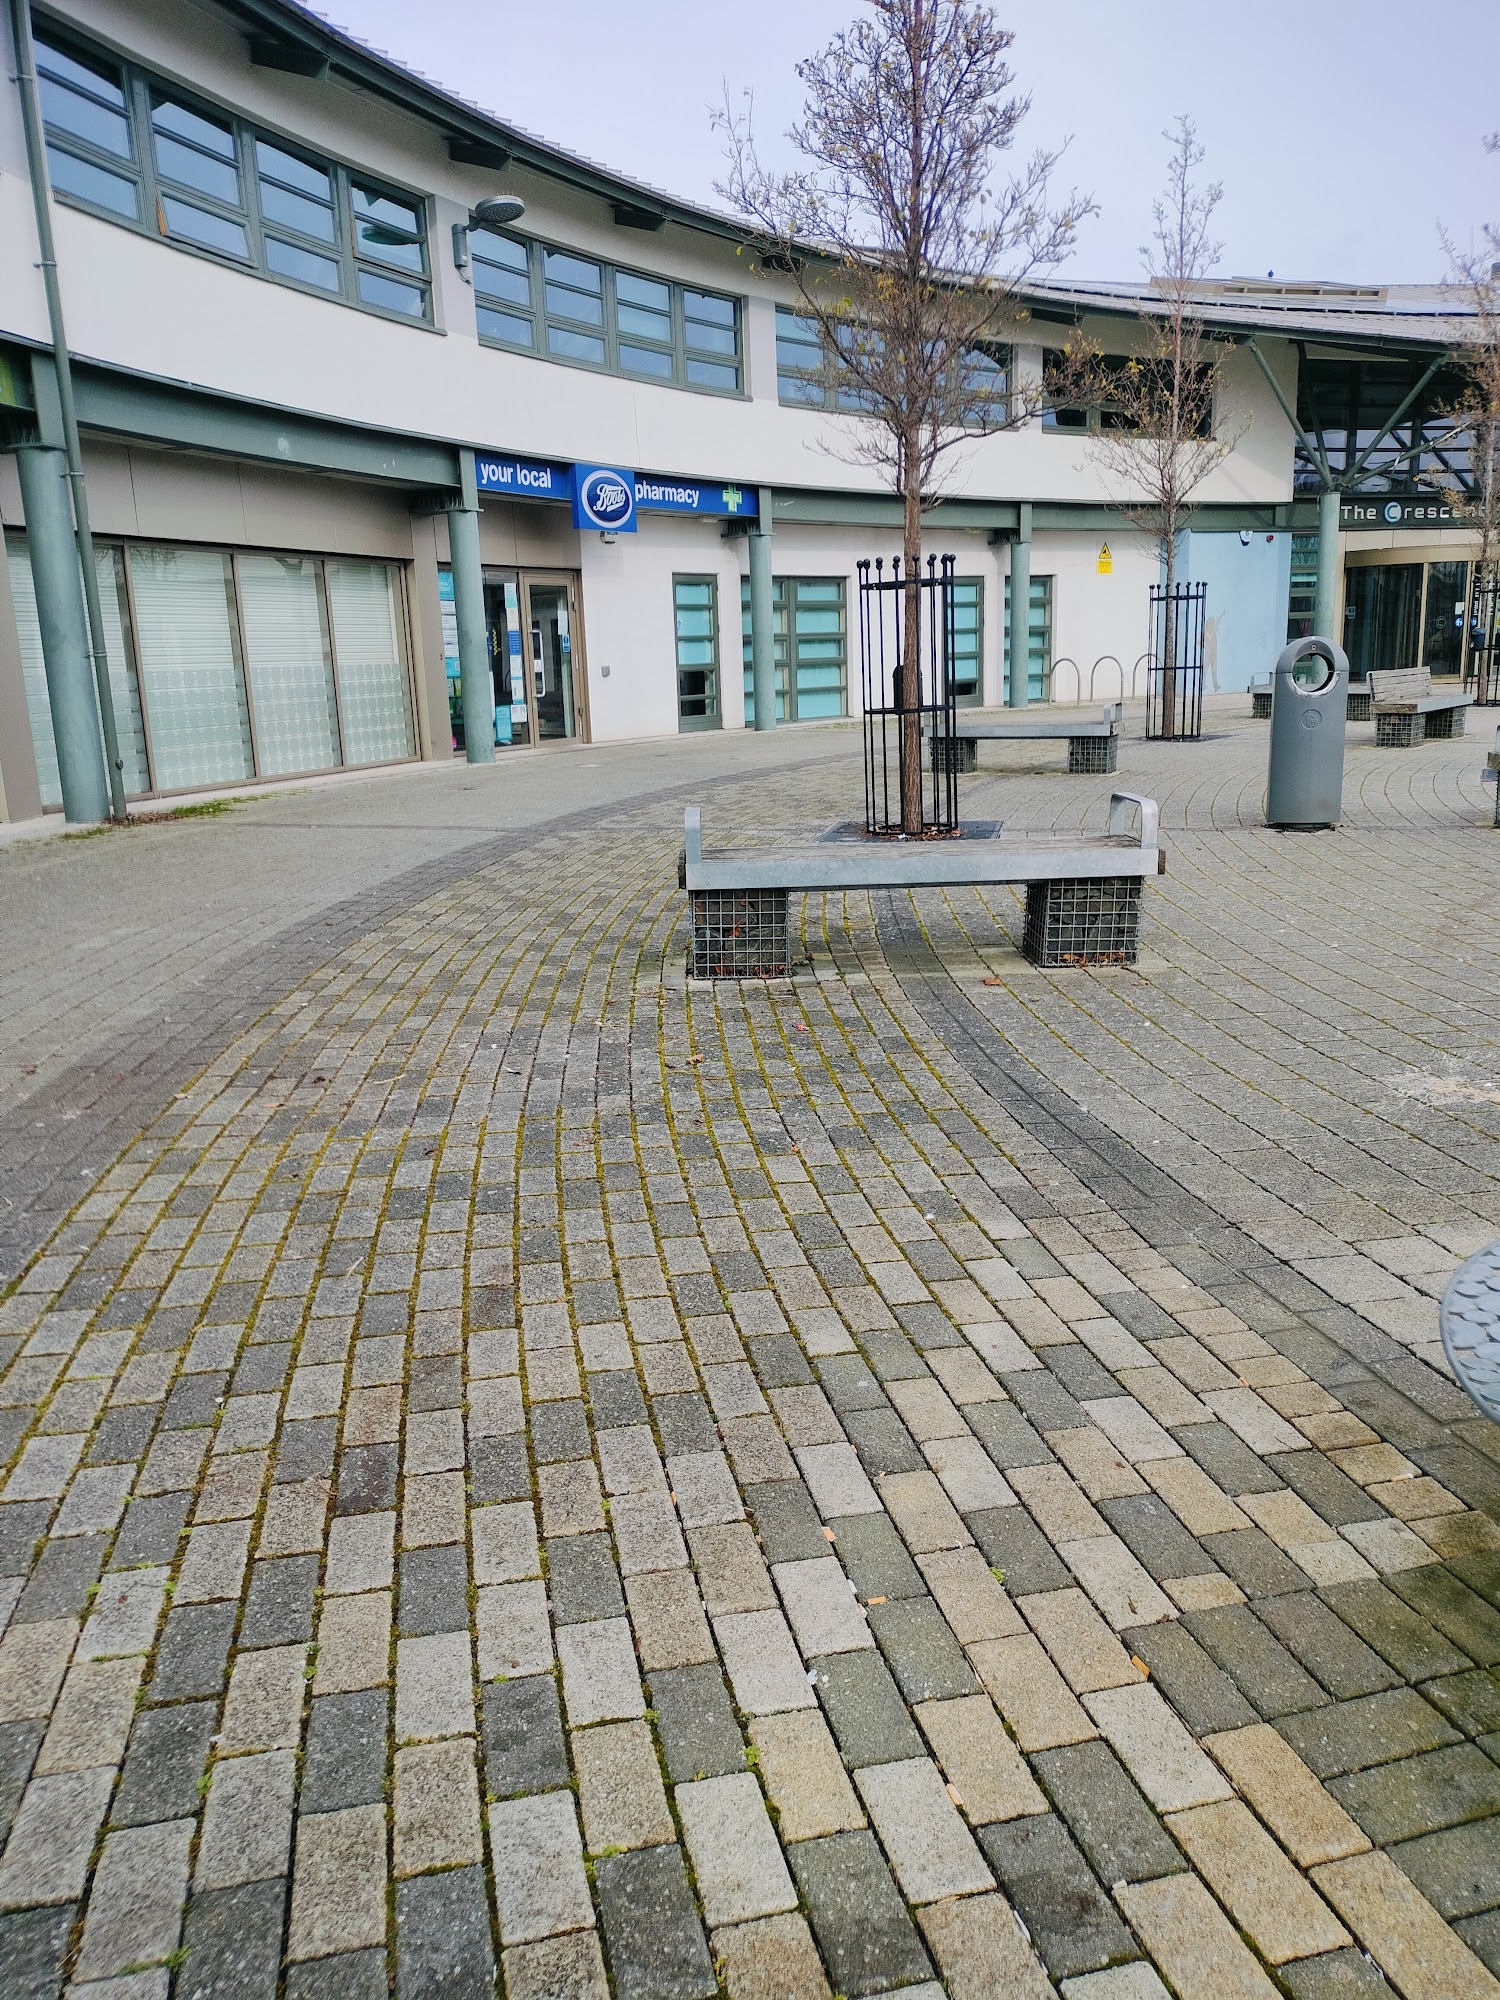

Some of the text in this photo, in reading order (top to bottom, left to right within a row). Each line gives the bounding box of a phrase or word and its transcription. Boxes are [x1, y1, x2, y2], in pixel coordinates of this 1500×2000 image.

[480, 462, 552, 488] your local
[593, 483, 626, 513] Boots
[634, 479, 700, 508] pharmacy
[1340, 505, 1377, 520] The
